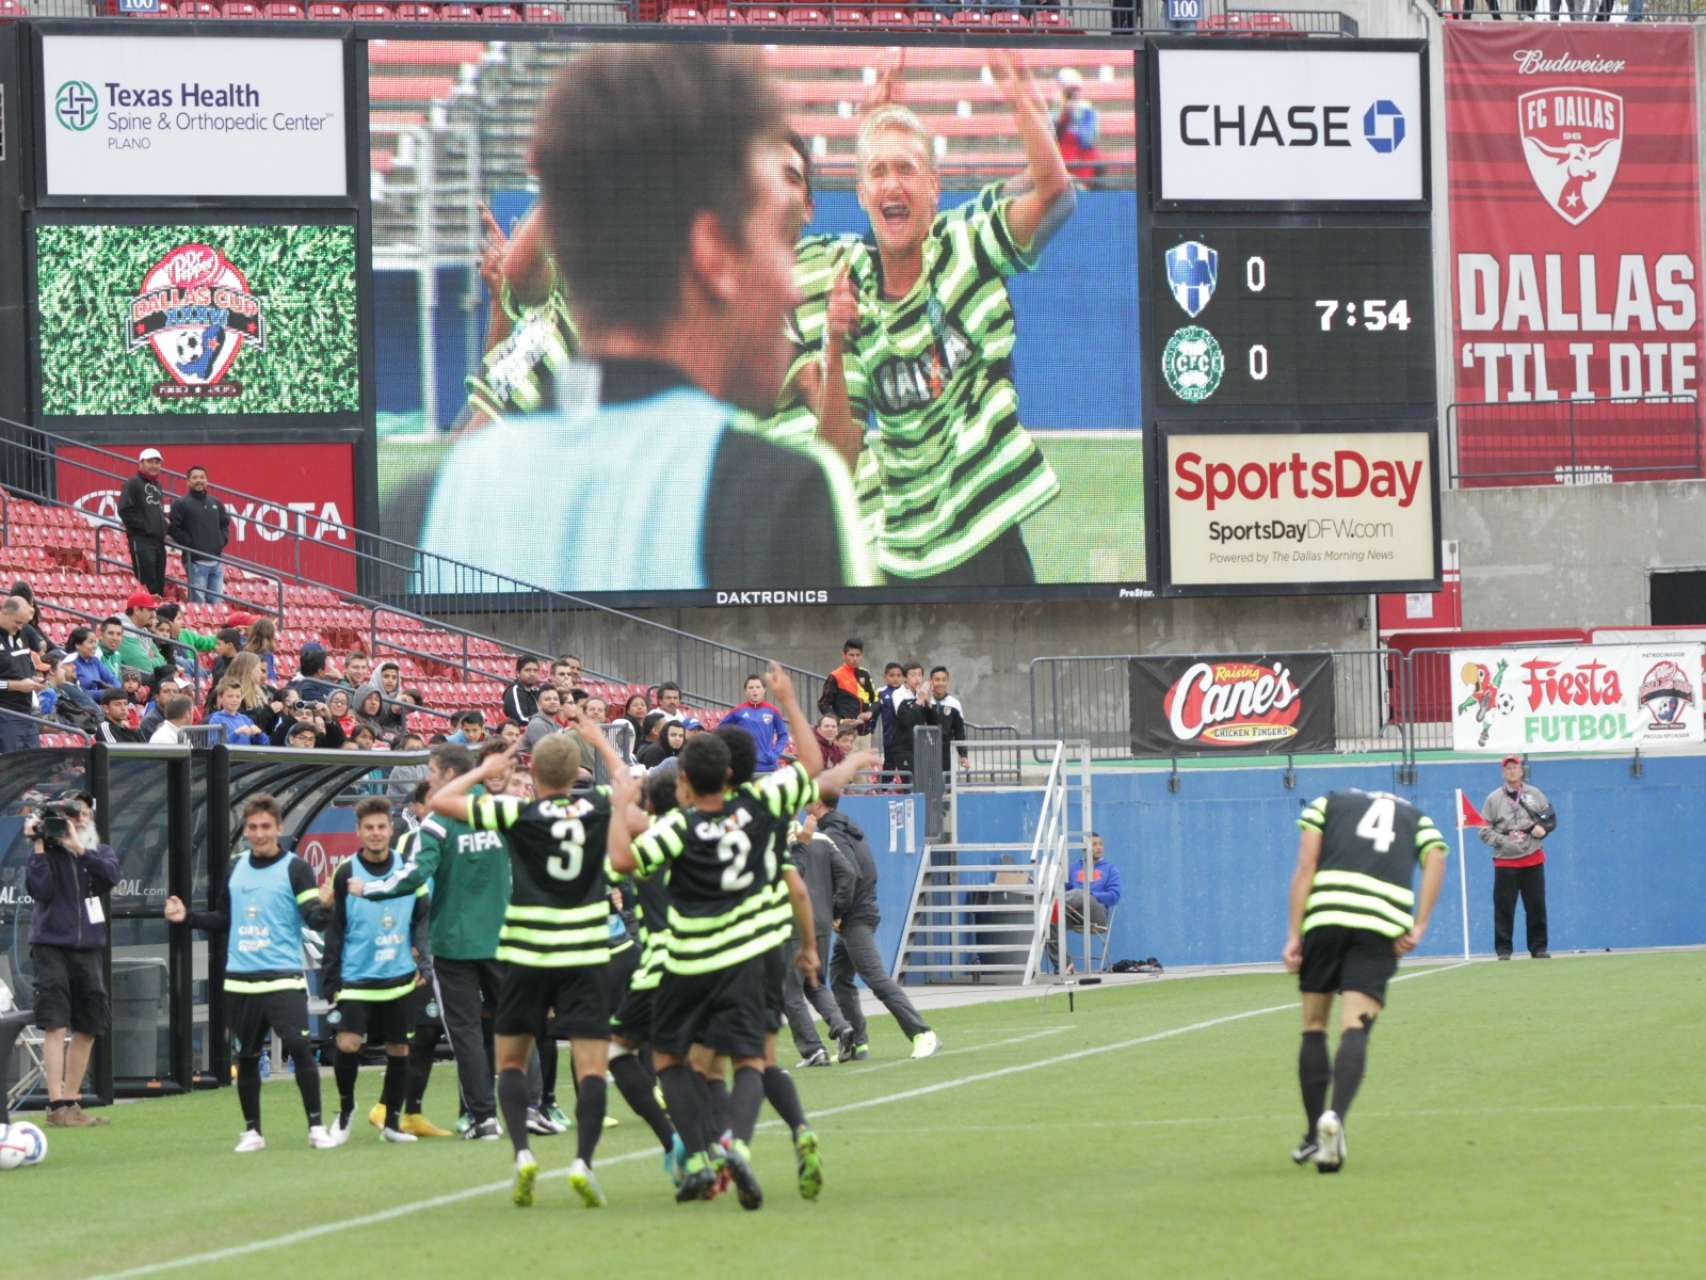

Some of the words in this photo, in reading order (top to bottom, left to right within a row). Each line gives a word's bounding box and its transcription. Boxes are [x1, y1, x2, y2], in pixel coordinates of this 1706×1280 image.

[1173, 0, 1198, 18] 100
[1513, 49, 1626, 74] Budweiser
[105, 83, 173, 107] Texas
[181, 83, 260, 107] Health
[107, 112, 151, 132] Spine
[157, 113, 172, 130] &
[176, 112, 268, 132] Orthopedic
[273, 112, 327, 131] Center
[1179, 105, 1352, 146] CHASE
[1527, 98, 1548, 130] FC
[1554, 96, 1615, 131] DALLAS
[108, 137, 151, 150] PLANO
[1246, 256, 1266, 291] 0
[132, 286, 211, 321] DALLAS
[214, 288, 258, 317] CUP
[1458, 253, 1697, 331] DALLAS
[1315, 300, 1411, 331] 7:54
[1249, 344, 1268, 380] 0
[1569, 342, 1596, 403] I
[1609, 342, 1698, 403] DIE
[1175, 450, 1423, 511] SportsDay
[1208, 519, 1394, 544] SportsDayDFW.com
[1209, 552, 1254, 563] Powered
[1256, 552, 1269, 564] by
[1272, 551, 1290, 562] The
[1292, 550, 1322, 562] Dallas
[1324, 550, 1365, 563] Morning
[1367, 550, 1394, 561] News
[716, 590, 829, 605] DAKTRONICS
[1215, 665, 1260, 682] Raising
[1520, 656, 1623, 712] Fiesta
[1170, 662, 1300, 740] Cane's
[1524, 713, 1633, 743] FUTBOL
[457, 830, 503, 854] FIFA
[1356, 798, 1396, 853] 4
[546, 818, 586, 881] 3
[717, 830, 755, 892] 2
